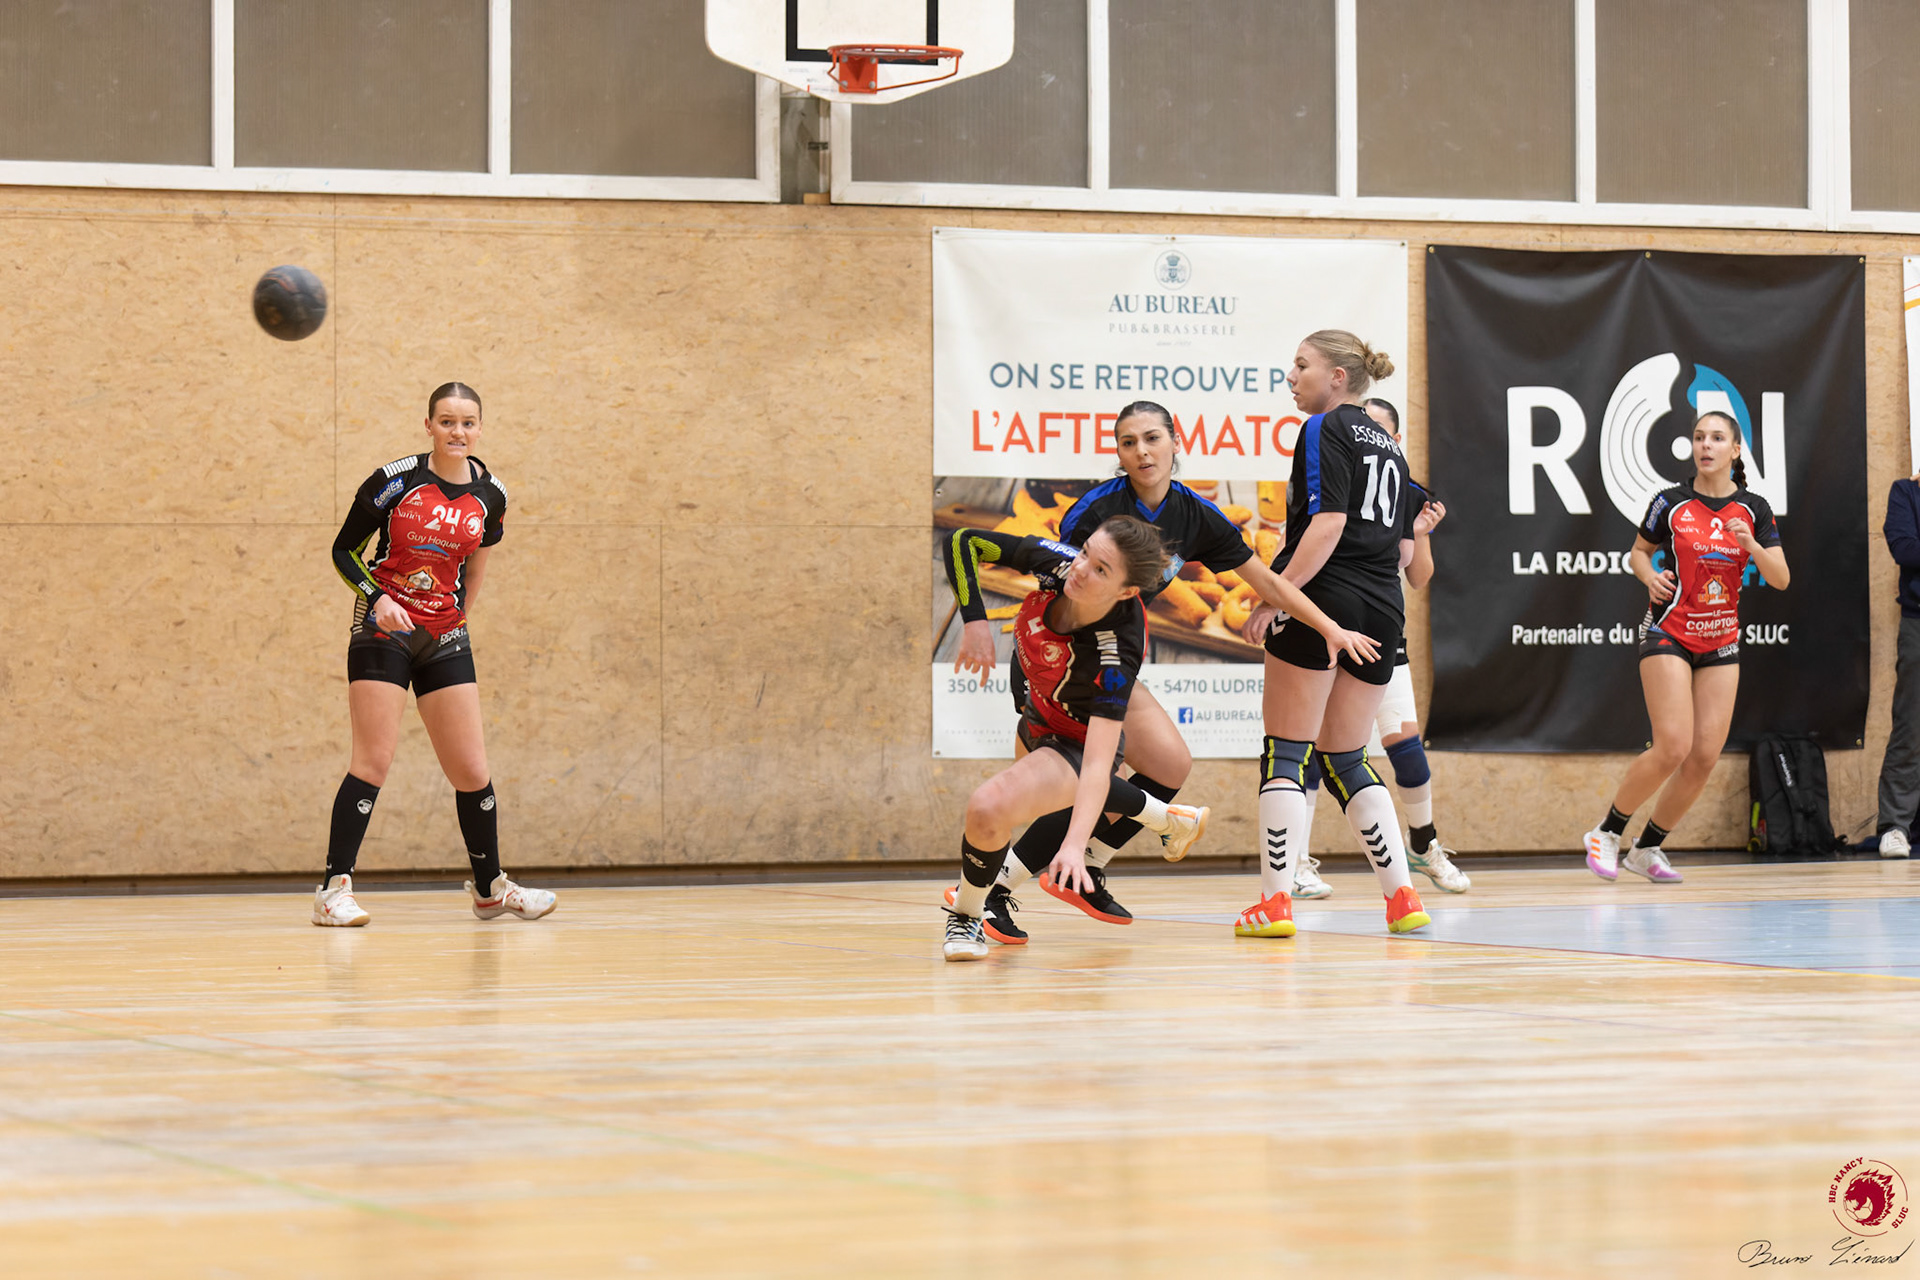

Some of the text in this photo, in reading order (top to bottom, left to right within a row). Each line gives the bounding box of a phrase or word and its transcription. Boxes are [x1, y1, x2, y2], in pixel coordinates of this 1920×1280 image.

[1108, 293, 1237, 316] AU BUREAU
[1108, 322, 1238, 337] PUB&BRASSERIE
[989, 362, 1039, 389] ON
[1049, 363, 1084, 390] SE
[1095, 364, 1259, 393] RETROUVE
[971, 409, 1304, 457] L'AFTE MATC
[1360, 454, 1401, 529] 10
[424, 505, 462, 535] 24
[1709, 517, 1724, 541] 2
[406, 531, 461, 551] Guy Hoquet
[1692, 542, 1741, 556] Guy Hoquet
[1512, 551, 1548, 575] LA
[1712, 609, 1722, 617] LE
[1511, 623, 1603, 646] Partenaire
[1608, 622, 1635, 646] du
[1745, 624, 1790, 646] SLUC
[947, 678, 1013, 694] 350 RU
[1163, 678, 1208, 694] 54710
[1212, 679, 1265, 694] LUDRE
[1196, 710, 1264, 722] AU BUREAU
